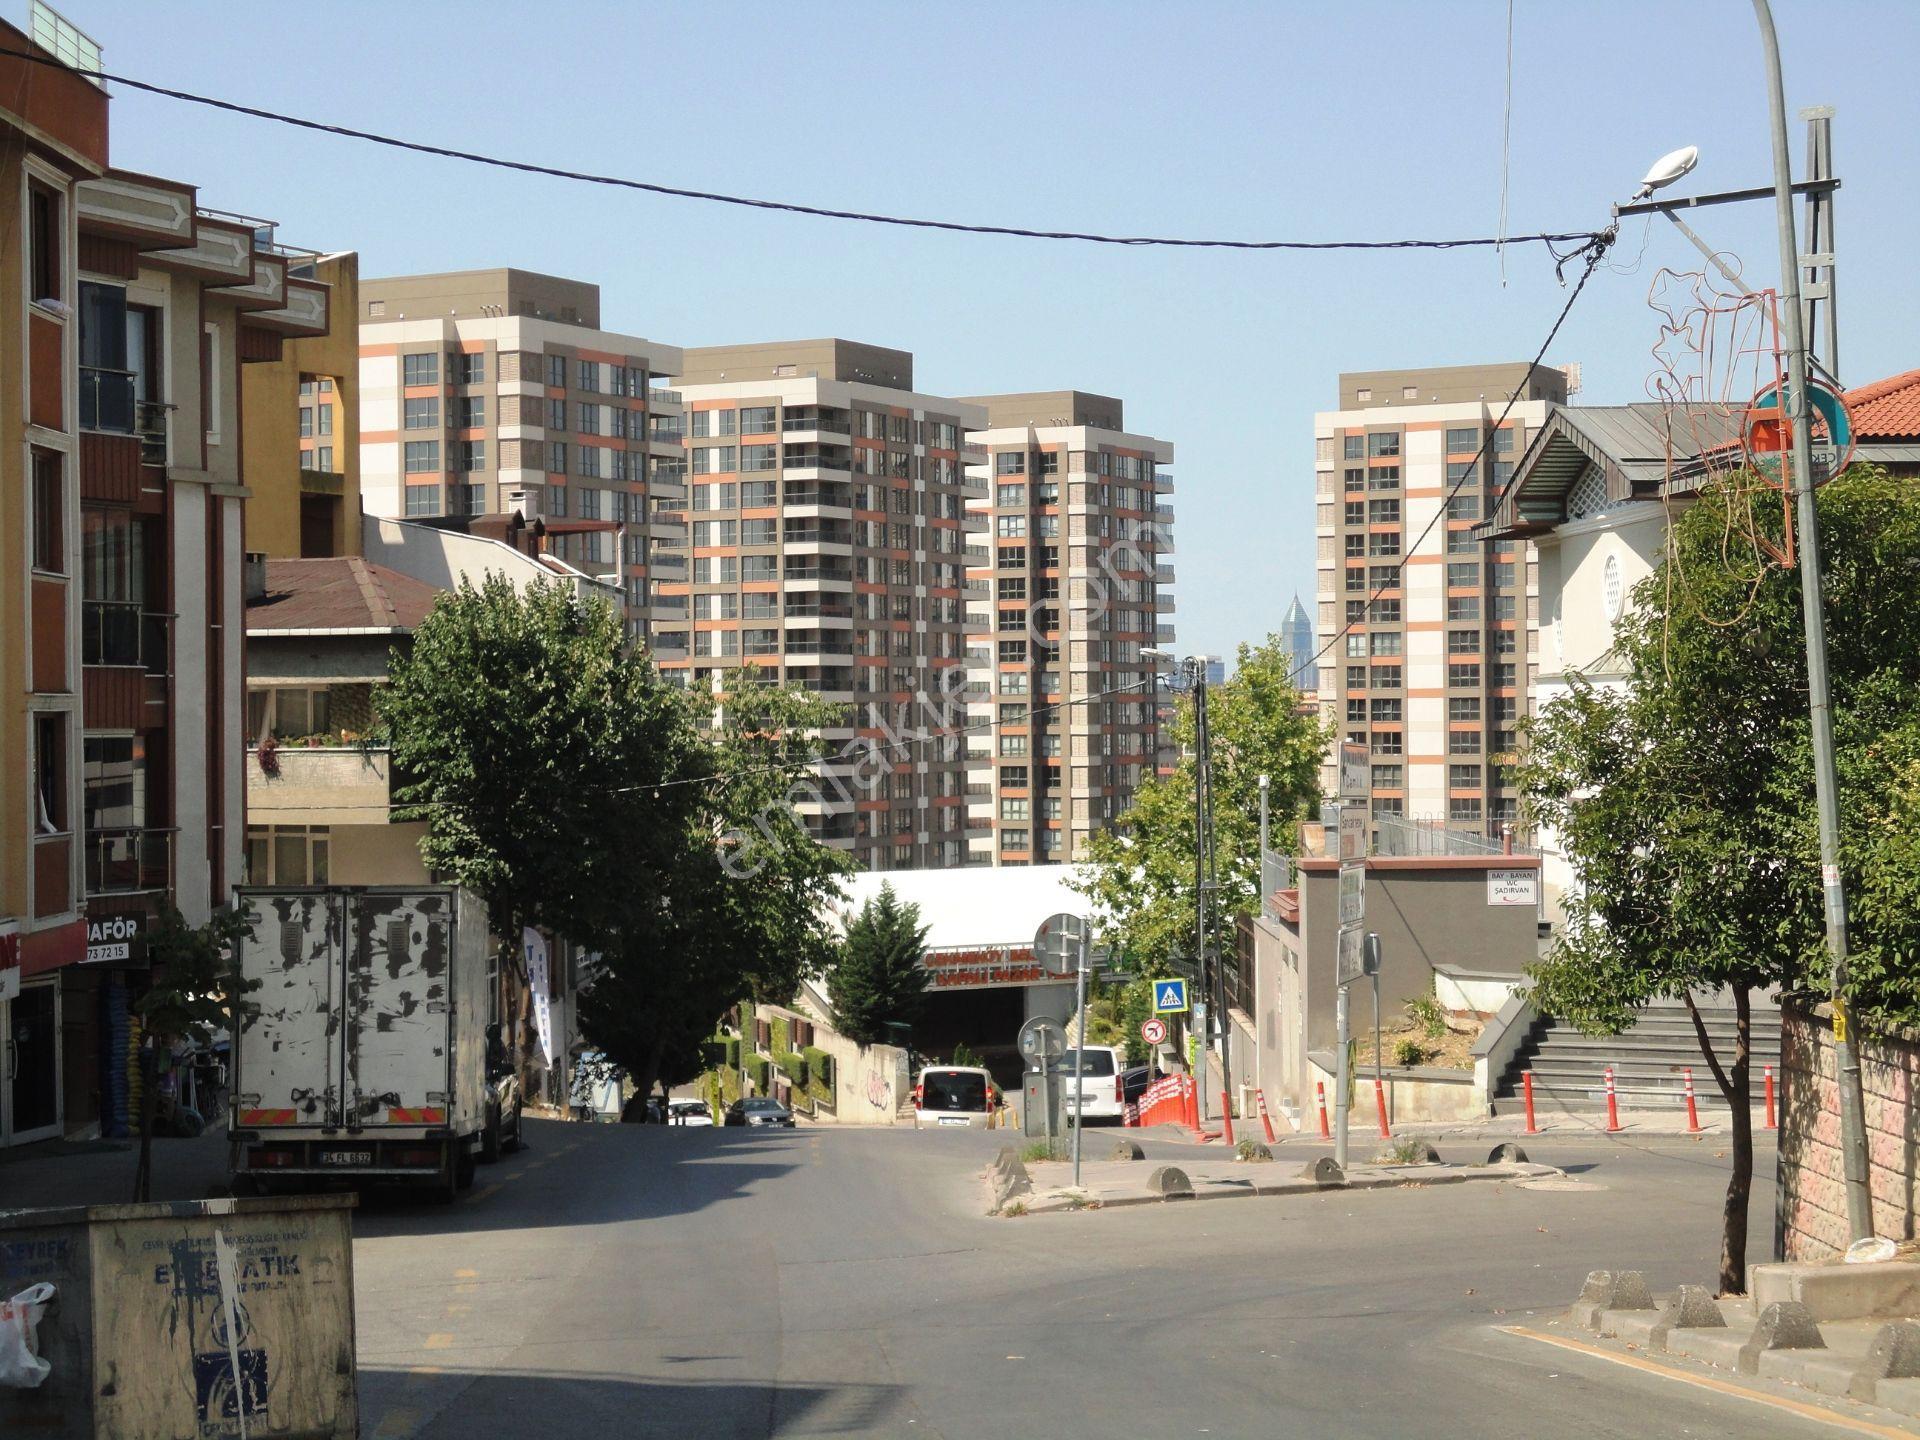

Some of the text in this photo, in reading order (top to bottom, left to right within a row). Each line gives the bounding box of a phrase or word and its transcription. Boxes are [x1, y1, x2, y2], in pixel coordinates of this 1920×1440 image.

[1495, 887, 1529, 895] ŞADIRVAN
[101, 948, 112, 959] 72
[115, 946, 124, 957] 15
